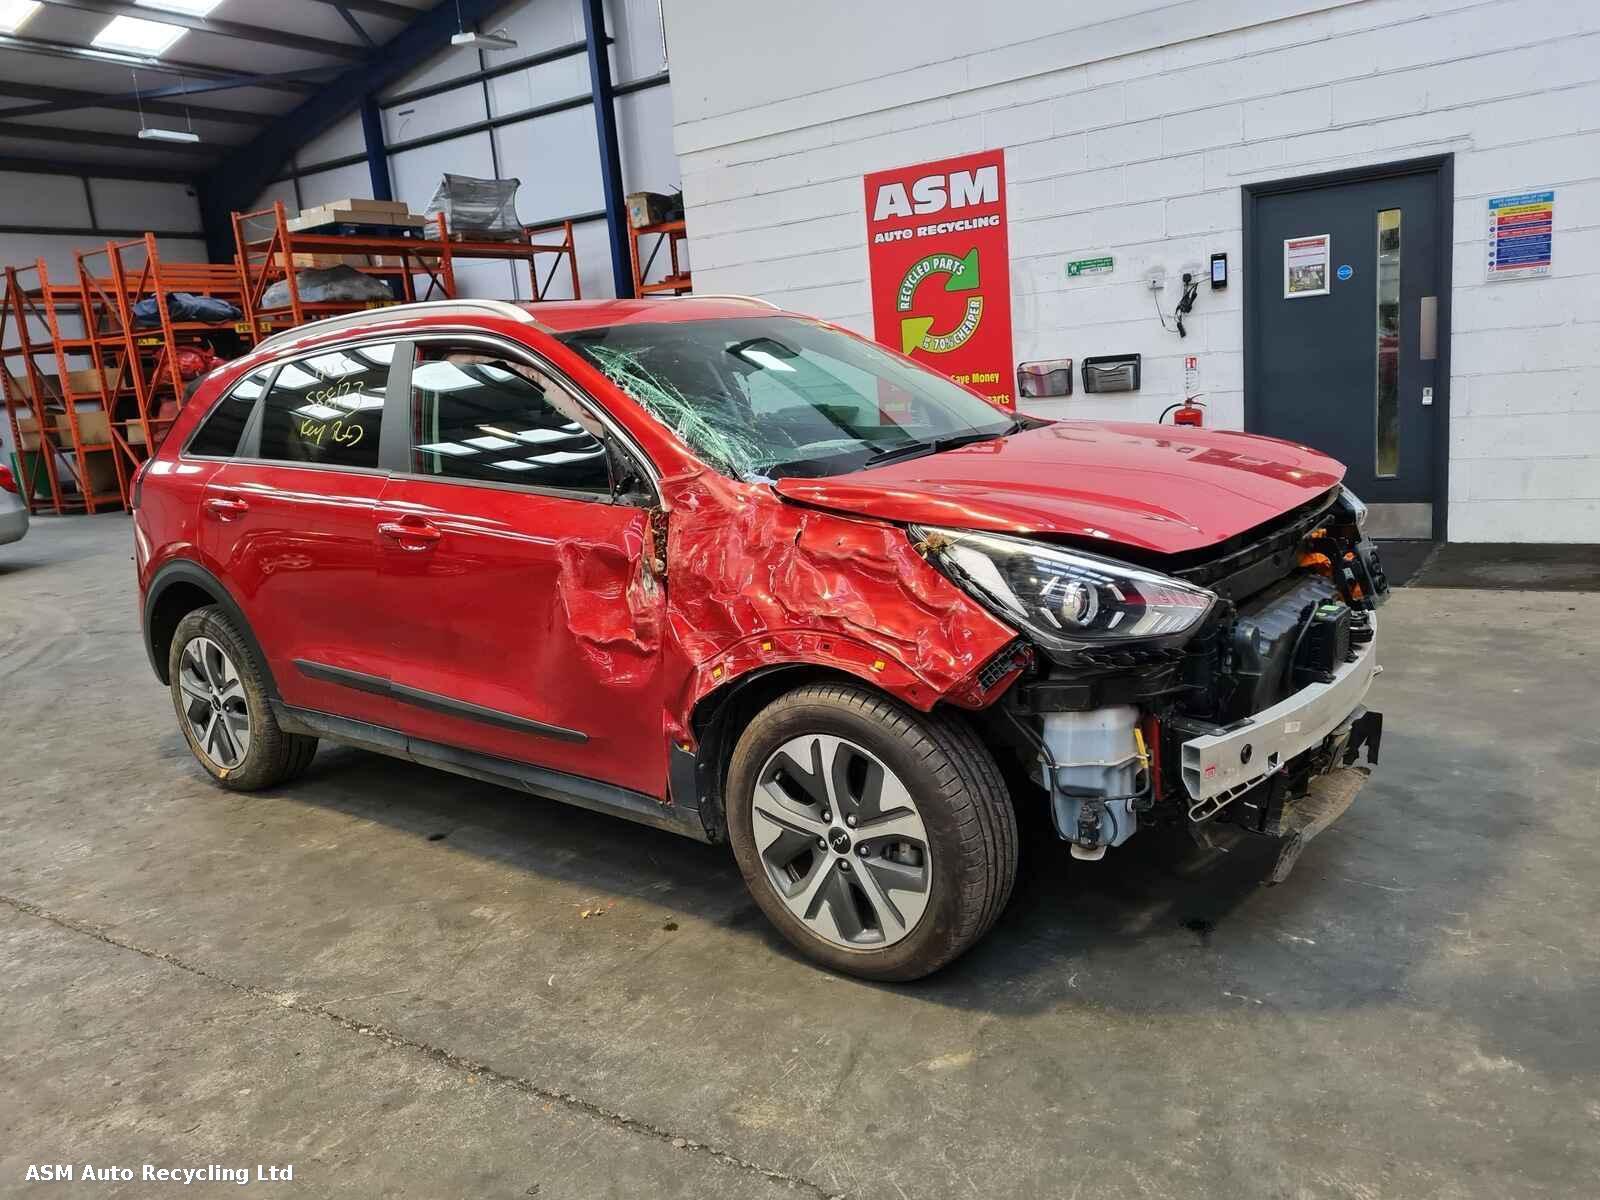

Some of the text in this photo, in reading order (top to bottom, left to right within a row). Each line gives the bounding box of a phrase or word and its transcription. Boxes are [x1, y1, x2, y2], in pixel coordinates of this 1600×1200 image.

[873, 165, 999, 221] ASM
[874, 215, 1000, 243] AUTO RECYCLING
[900, 257, 965, 309] RECYCLED PARTS
[953, 301, 980, 344] CHEAPER
[972, 372, 1000, 384] Money
[987, 394, 1009, 405] arts
